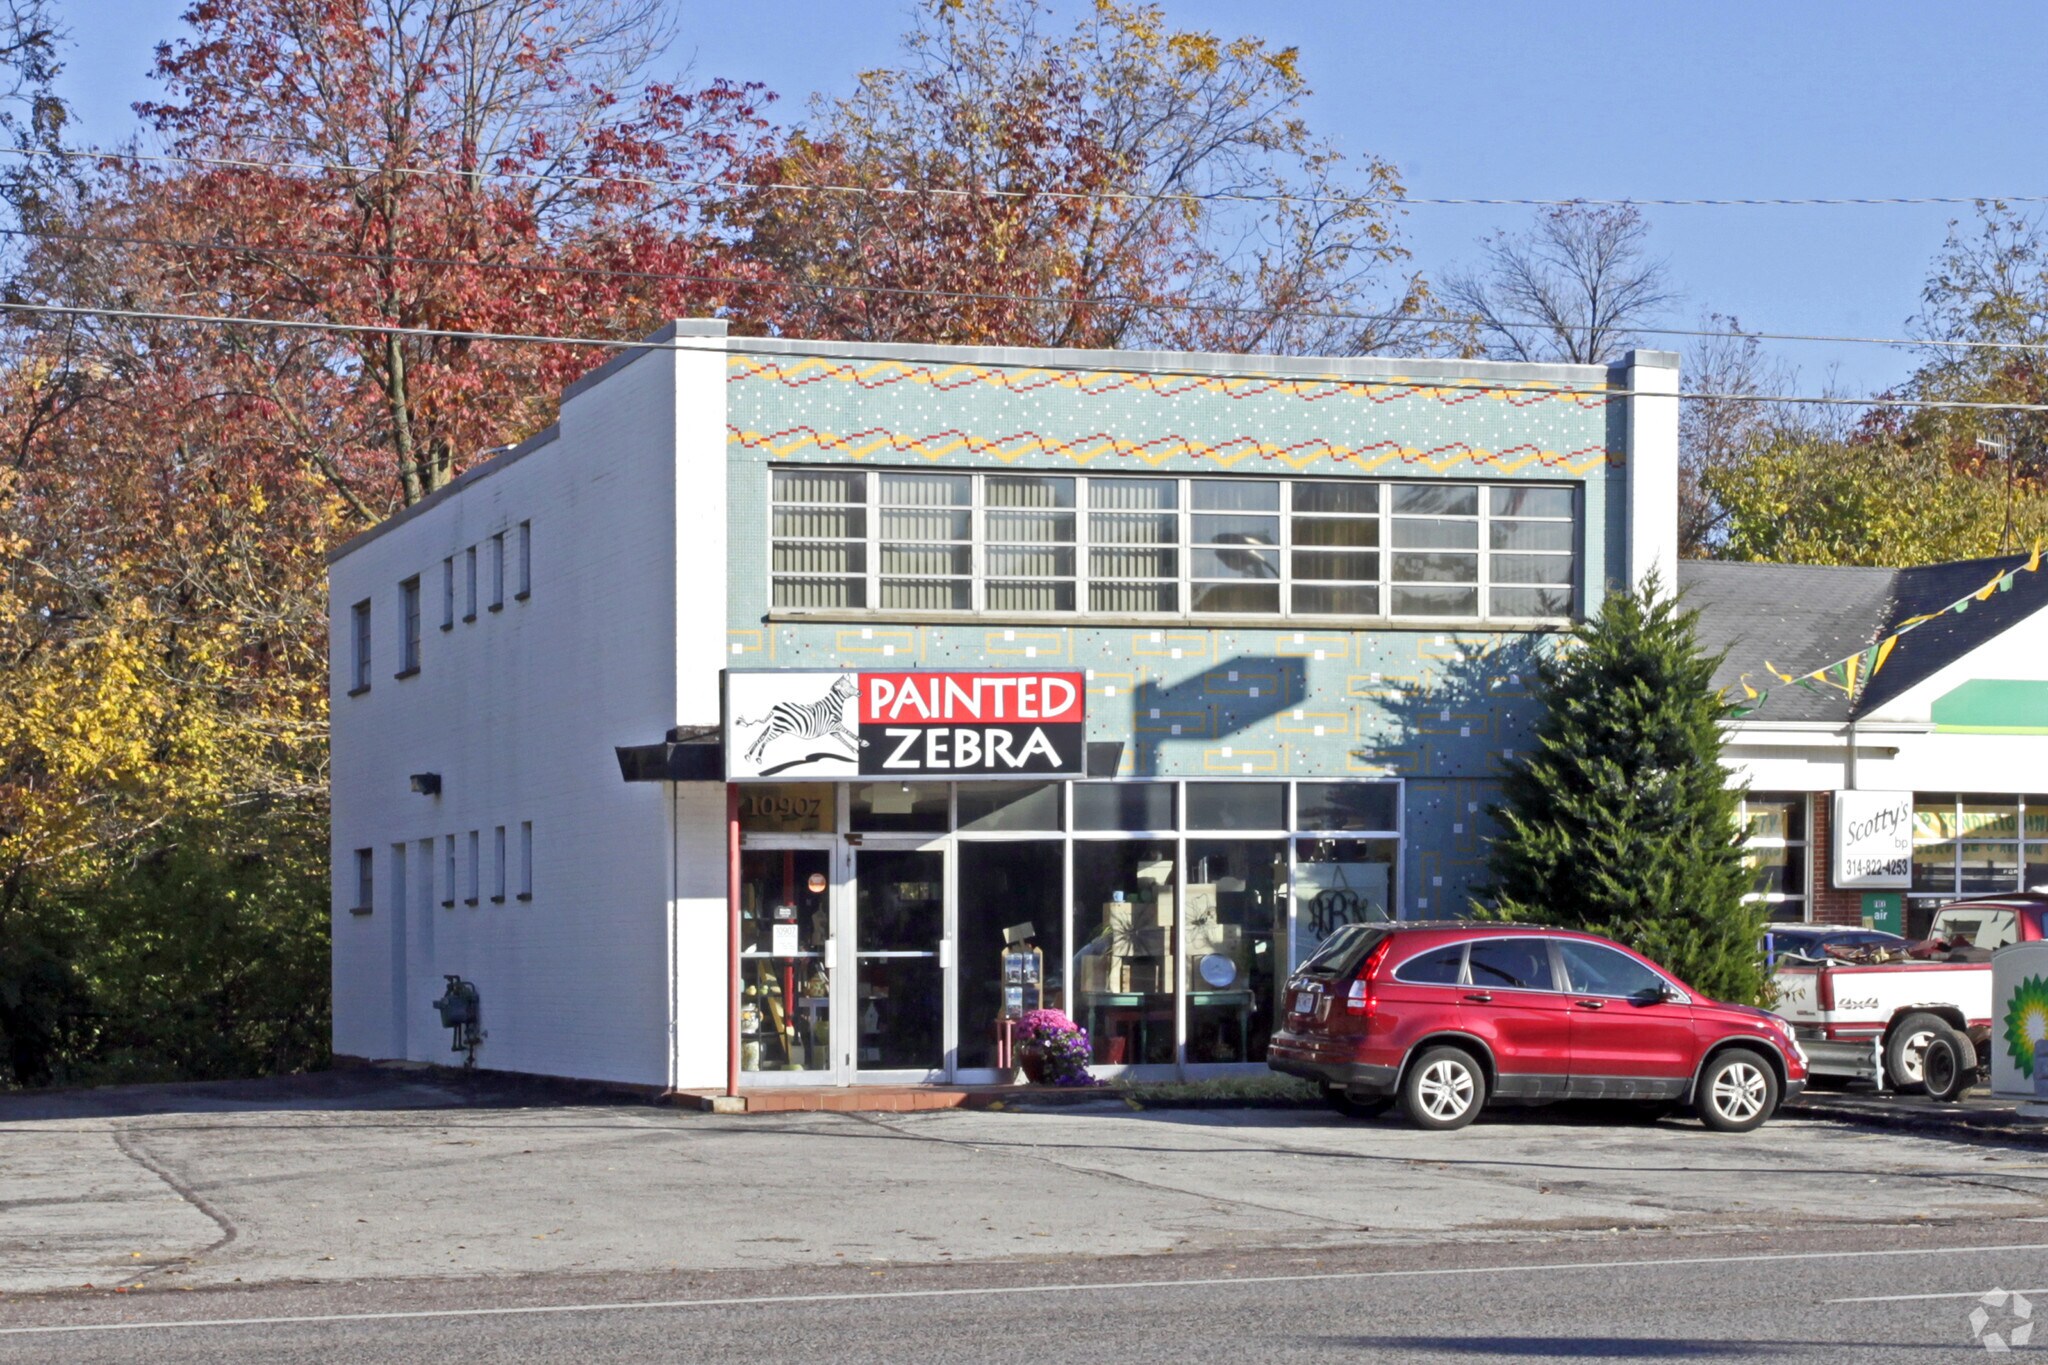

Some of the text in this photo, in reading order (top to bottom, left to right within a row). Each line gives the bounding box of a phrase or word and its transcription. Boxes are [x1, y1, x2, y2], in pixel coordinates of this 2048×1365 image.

[870, 676, 1076, 719] PAINTED
[882, 726, 1063, 768] ZEBRA
[1846, 801, 1909, 846] Scotty's
[1894, 836, 1909, 850] bp
[1846, 859, 1908, 876] 314-822-4253
[1874, 909, 1888, 920] air
